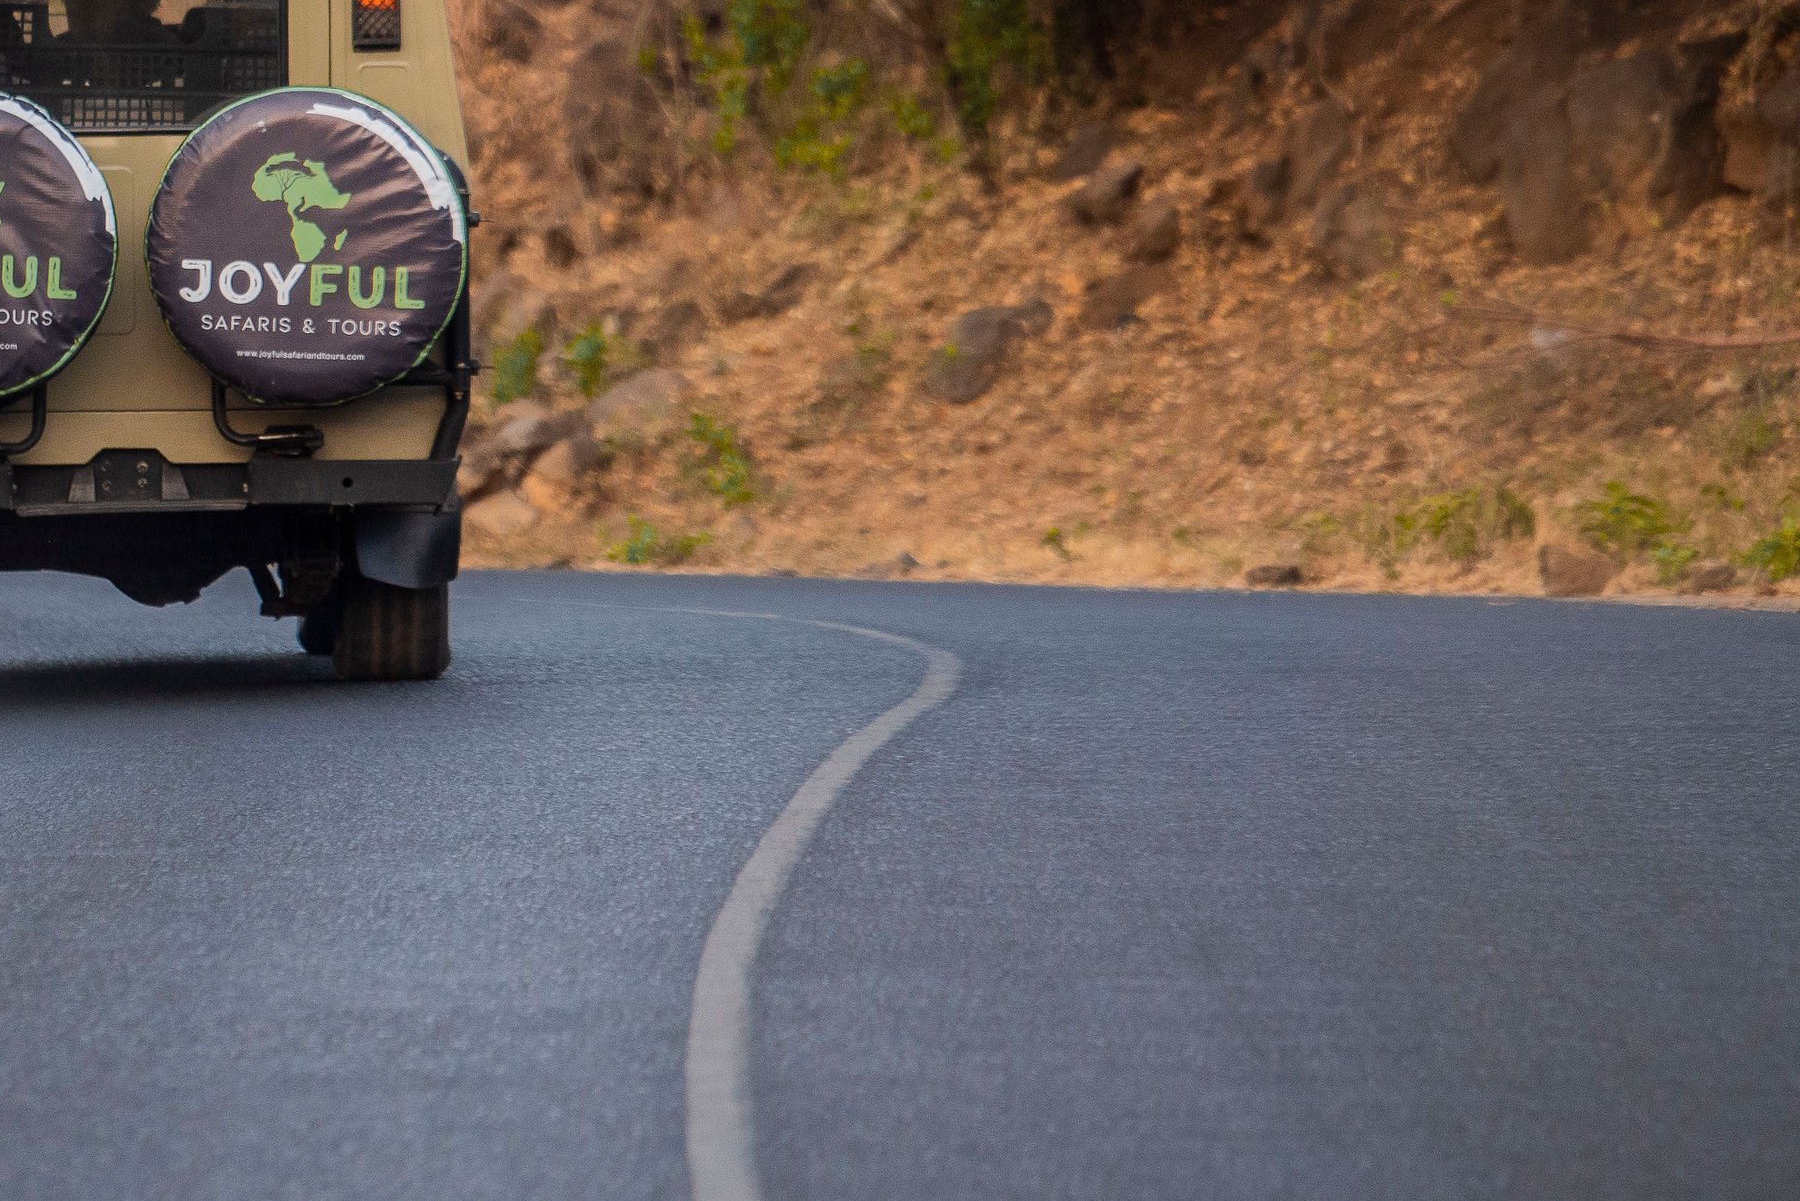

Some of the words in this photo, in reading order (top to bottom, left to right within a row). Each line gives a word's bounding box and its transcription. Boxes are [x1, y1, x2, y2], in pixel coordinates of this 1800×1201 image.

[178, 258, 427, 310] JOYFUL
[200, 313, 292, 334] SAFARIS
[302, 317, 316, 334] &
[327, 318, 402, 337] TOURS
